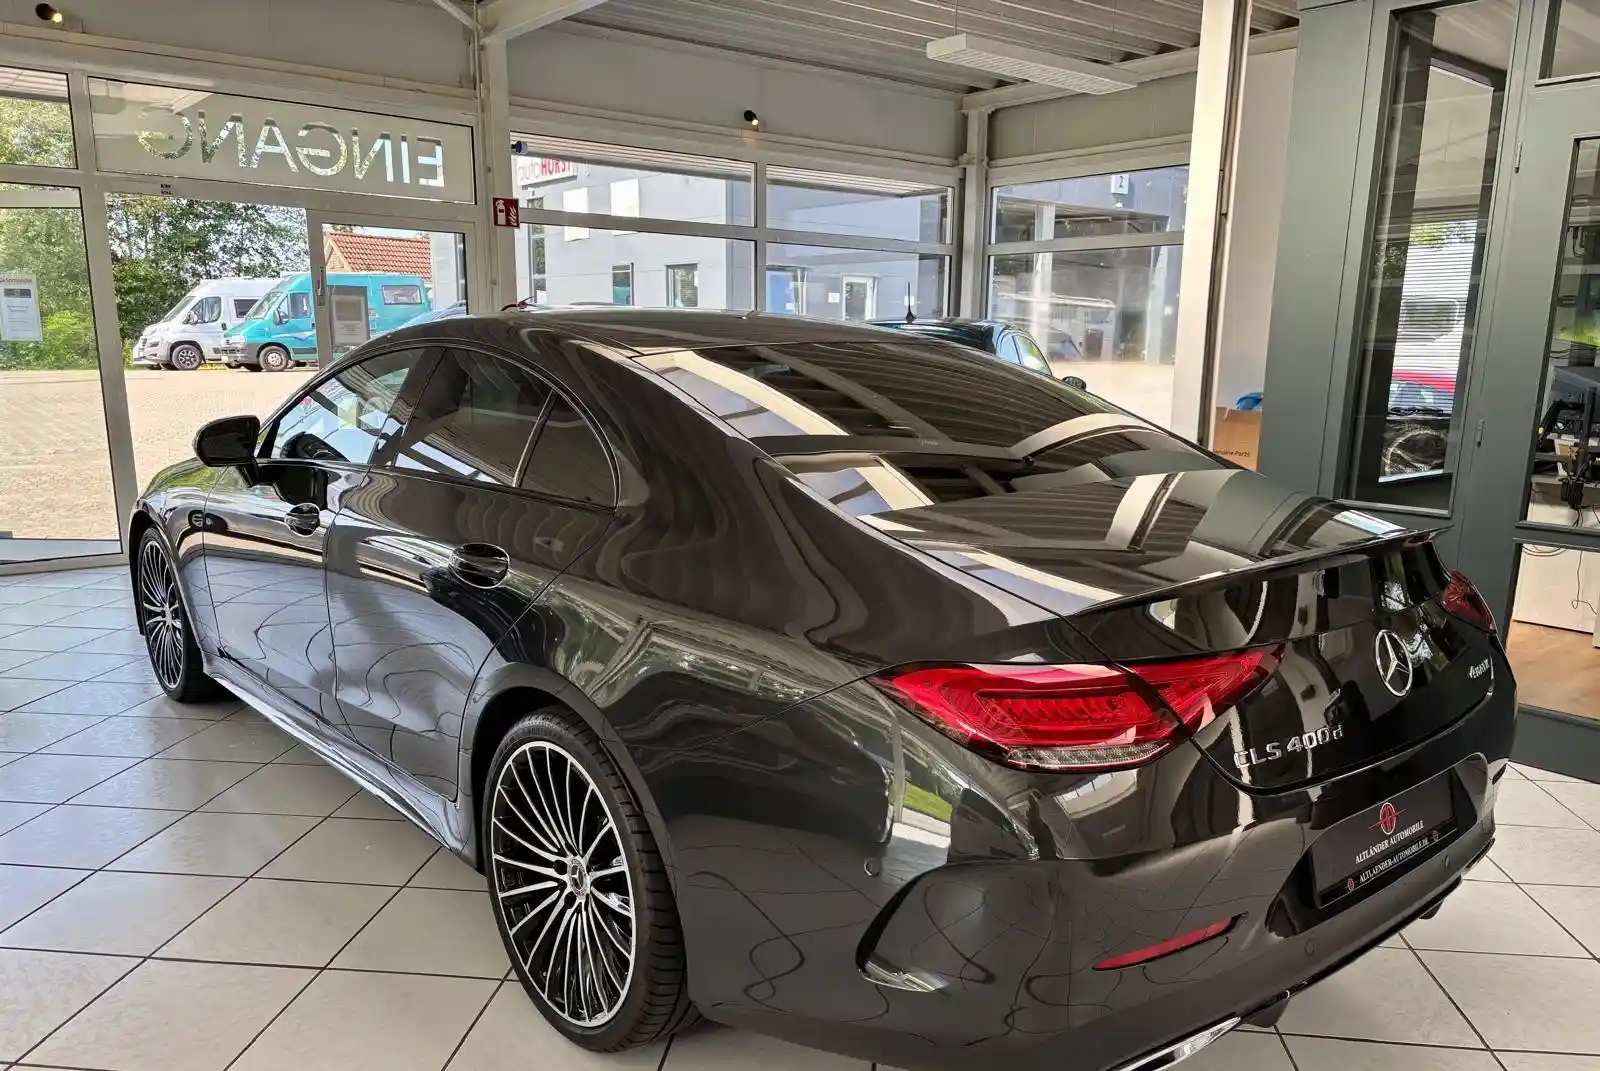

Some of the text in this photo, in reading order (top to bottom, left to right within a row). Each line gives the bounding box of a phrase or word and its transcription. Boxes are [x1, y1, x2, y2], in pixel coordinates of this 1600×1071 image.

[1233, 741, 1282, 769] CLS
[1355, 820, 1425, 864] ALTLÄNDER AUTOMOBILE
